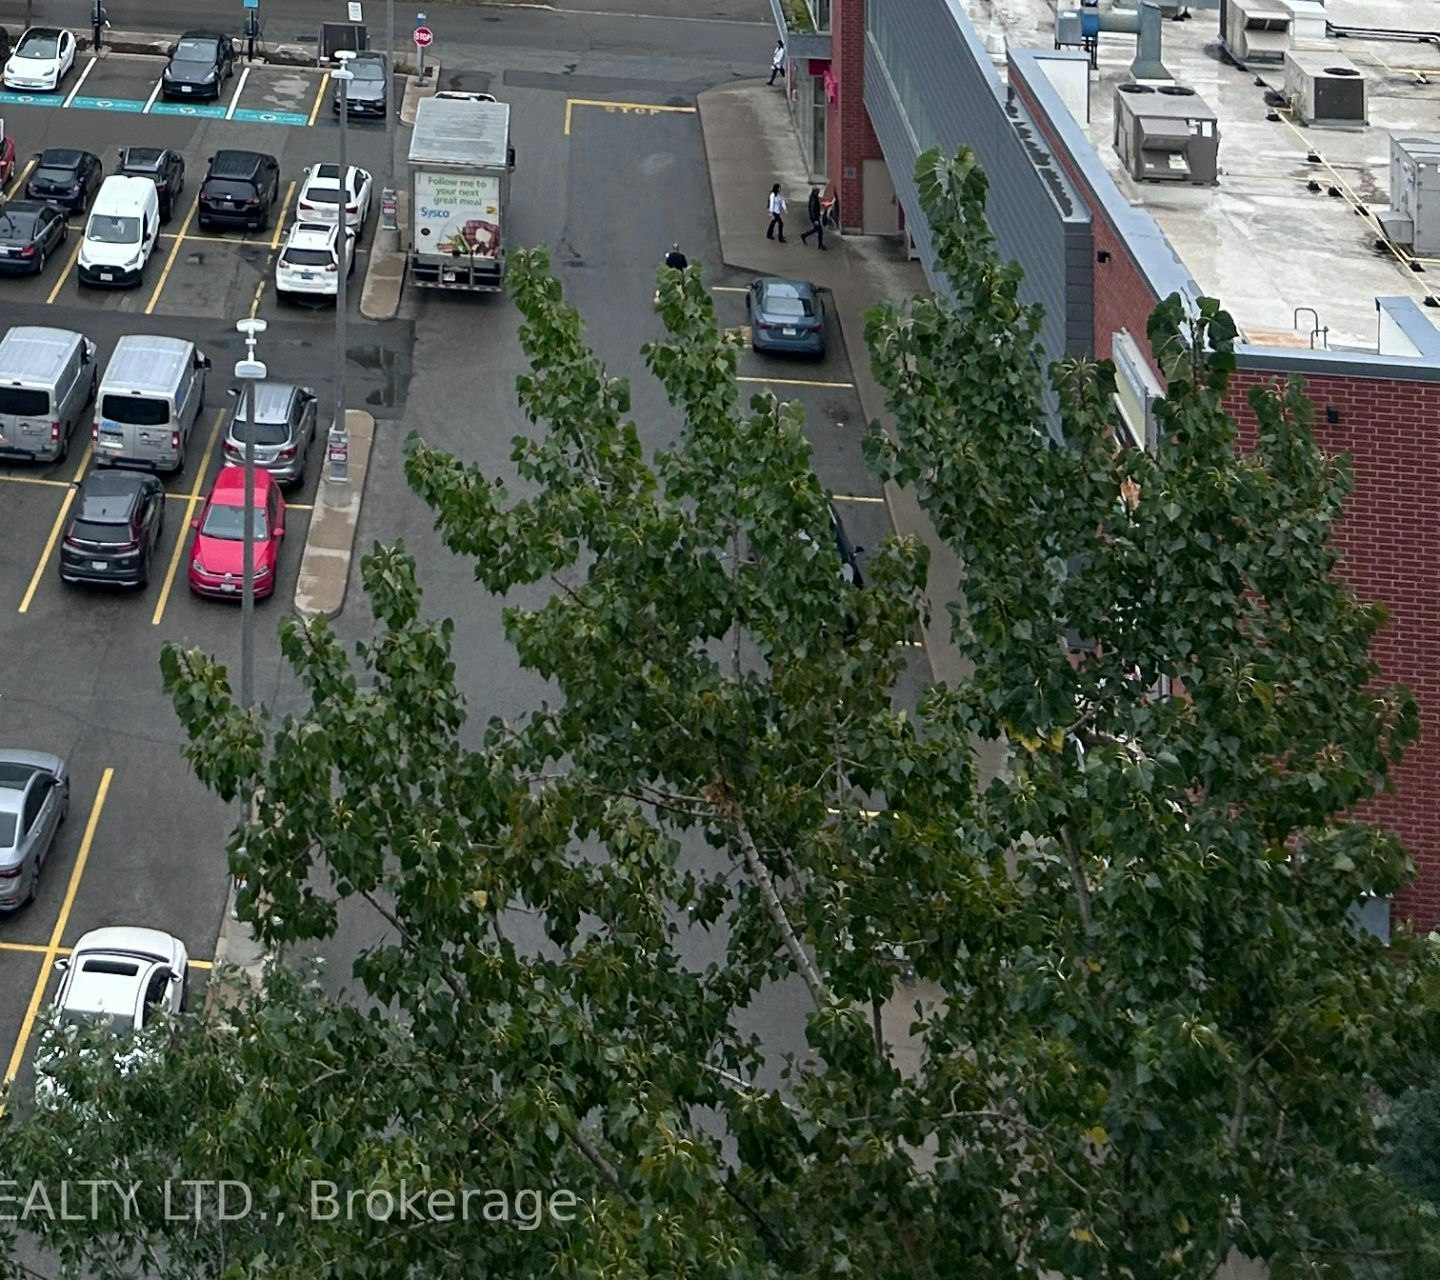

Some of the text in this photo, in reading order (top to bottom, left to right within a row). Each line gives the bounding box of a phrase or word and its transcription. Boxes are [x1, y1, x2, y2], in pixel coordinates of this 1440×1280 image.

[416, 31, 432, 41] STOP
[428, 176, 458, 186] Follow
[477, 179, 488, 188] to
[436, 187, 479, 197] your next
[433, 196, 482, 206] great meal
[421, 206, 450, 219] Sysco
